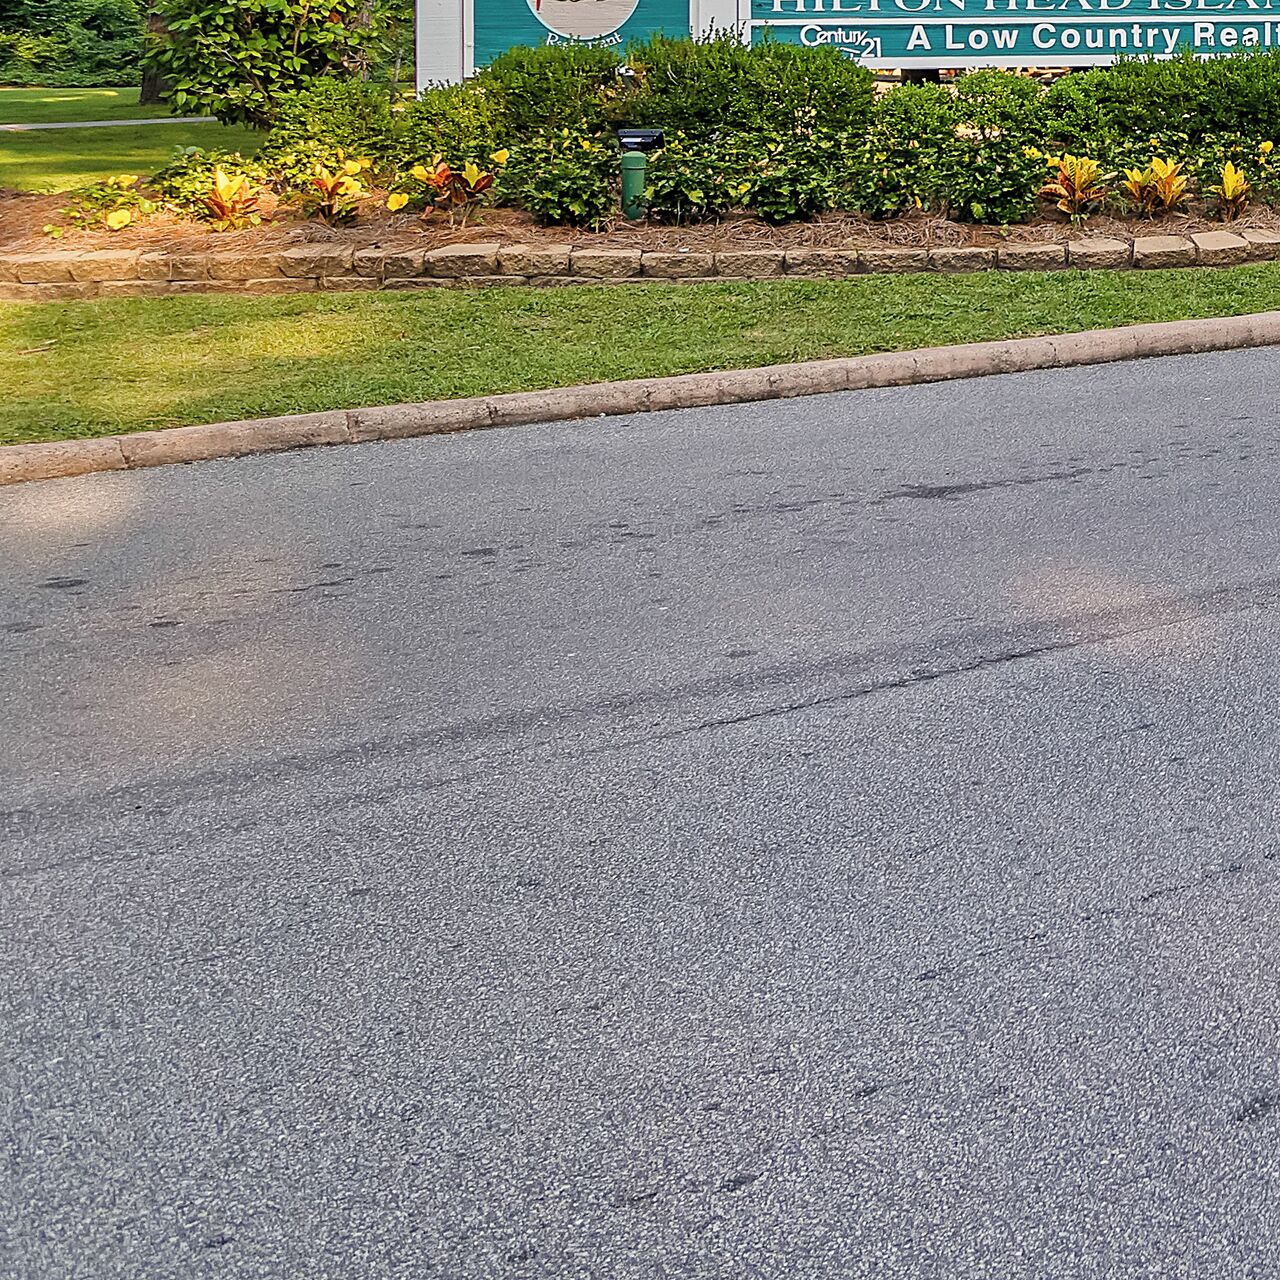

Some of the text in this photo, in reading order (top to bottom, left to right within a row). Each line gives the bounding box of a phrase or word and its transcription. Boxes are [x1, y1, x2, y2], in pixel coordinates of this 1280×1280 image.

[800, 24, 882, 58] Century 21
[907, 25, 931, 50] A
[945, 24, 1019, 50] Low
[1032, 23, 1180, 54] Country
